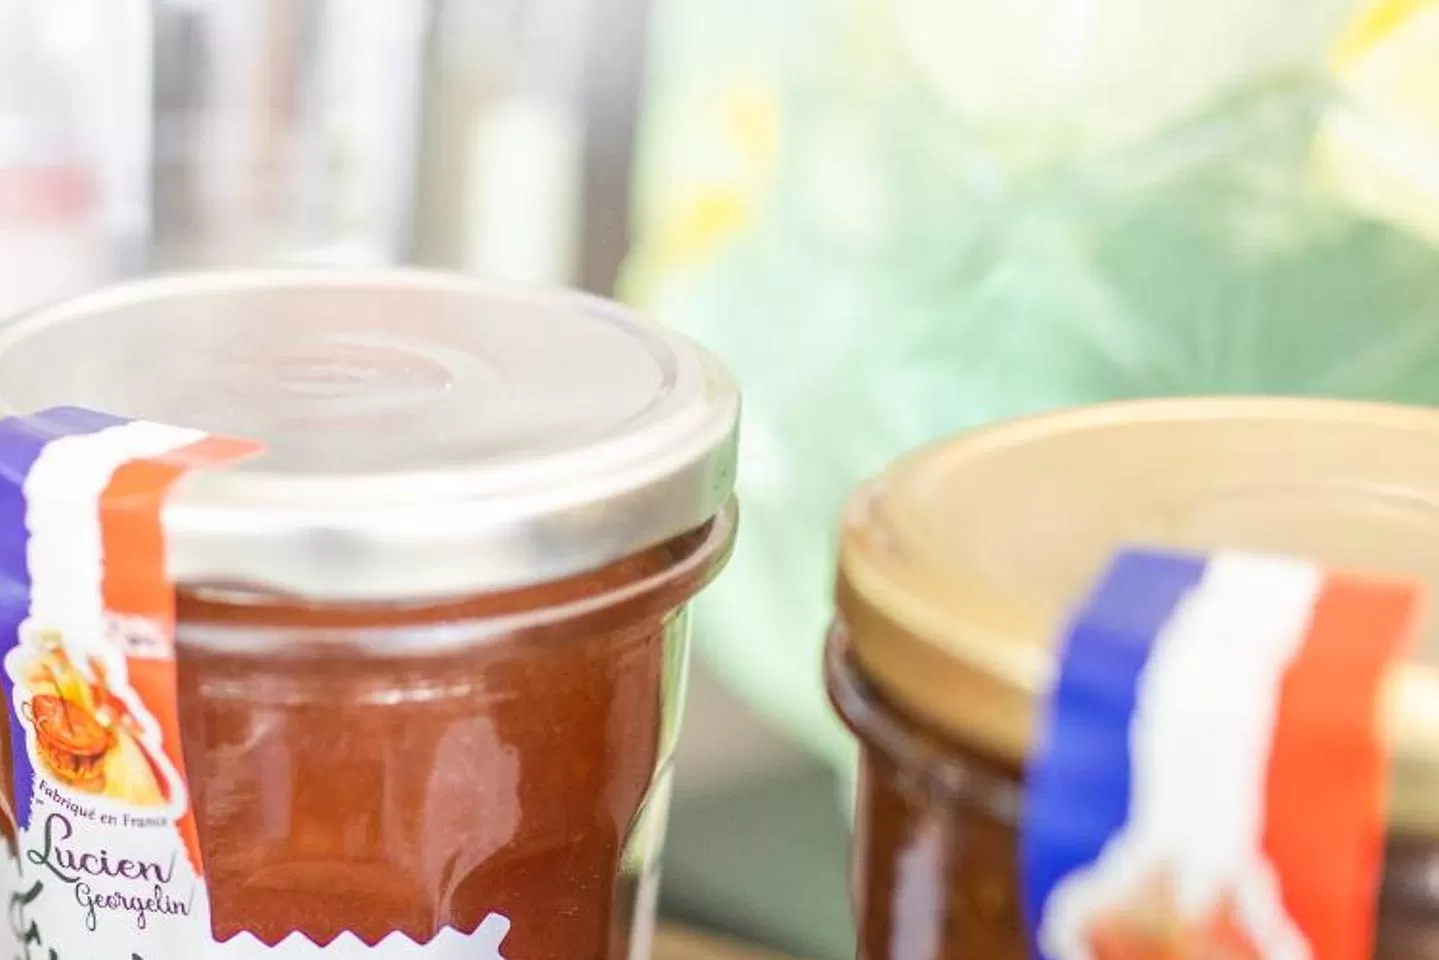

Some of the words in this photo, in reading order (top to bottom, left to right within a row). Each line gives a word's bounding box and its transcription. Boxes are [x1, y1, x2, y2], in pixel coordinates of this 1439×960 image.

[39, 779, 97, 821] Fabriqué
[100, 813, 118, 827] en
[27, 812, 178, 884] Lucien
[75, 882, 196, 932] Georgelin
